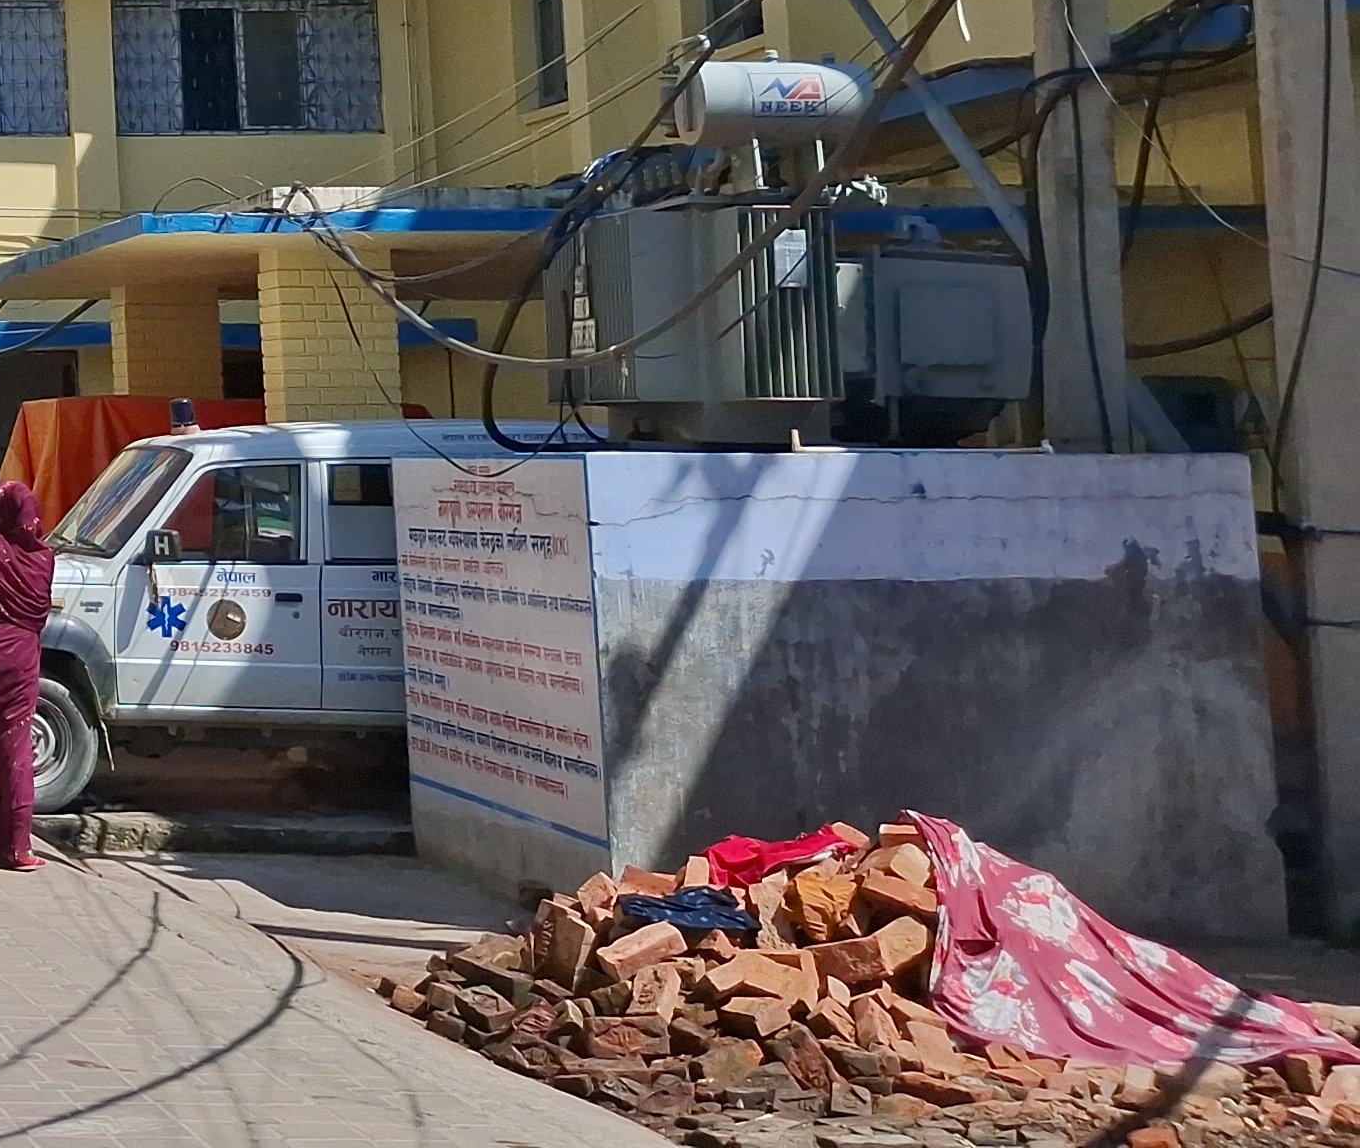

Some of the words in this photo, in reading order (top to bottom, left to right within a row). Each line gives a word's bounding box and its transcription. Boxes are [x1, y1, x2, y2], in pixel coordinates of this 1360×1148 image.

[760, 101, 818, 113] NEEK
[155, 537, 169, 555] H
[216, 568, 256, 583] नेपाल
[326, 599, 399, 619] नाराय
[170, 640, 274, 655] 9815233845
